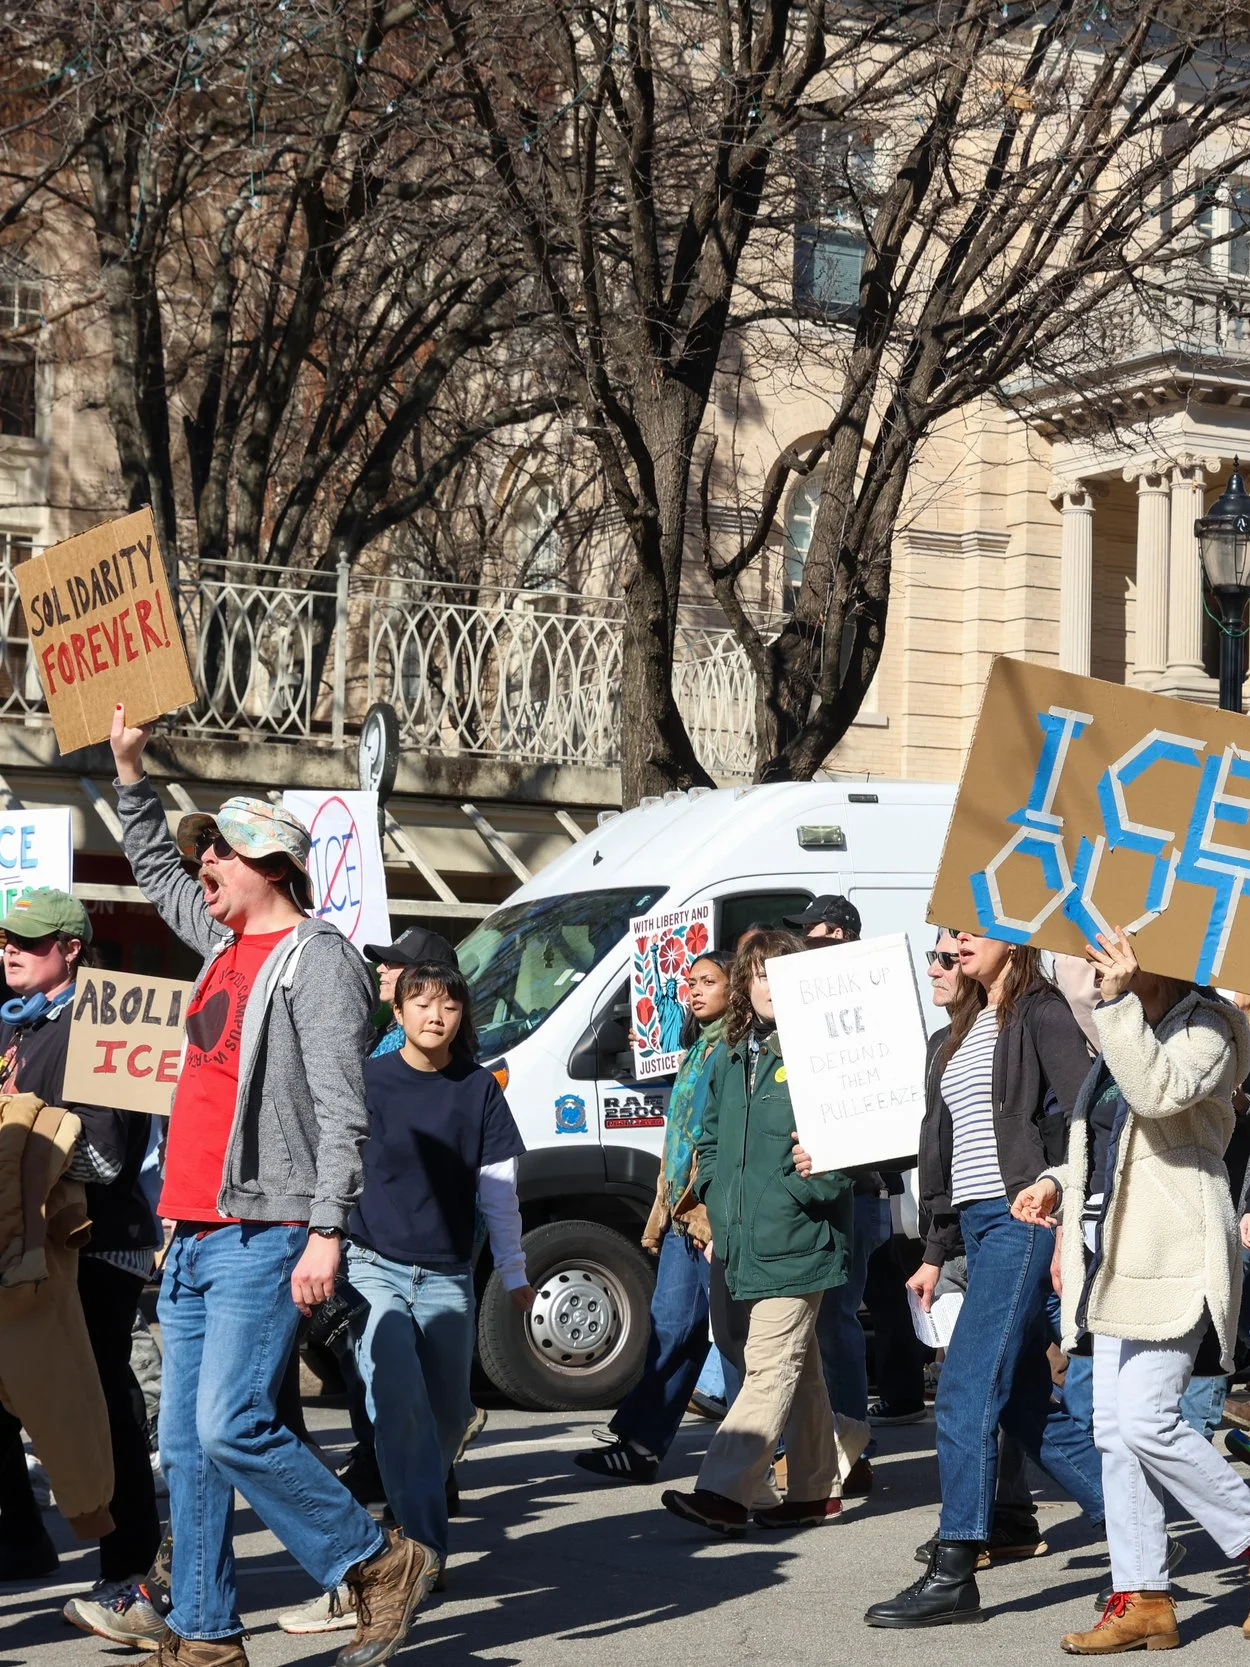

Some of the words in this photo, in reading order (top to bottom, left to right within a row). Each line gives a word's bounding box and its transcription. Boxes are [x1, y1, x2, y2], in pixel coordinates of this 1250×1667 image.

[31, 535, 153, 637] SOLIDARITY
[41, 589, 172, 696] FOREVER!
[311, 832, 361, 917] ICE
[633, 918, 654, 934] WITH
[656, 909, 690, 929] LIBERTY
[691, 905, 709, 921] AND
[73, 978, 183, 1028] ABOLI
[798, 972, 862, 1005] BREAK
[869, 967, 891, 986] UP
[824, 1005, 866, 1039] ICE
[92, 1039, 182, 1083] ICE
[639, 1056, 677, 1075] JUSTICE
[809, 1042, 891, 1075] DEFUND
[838, 1067, 881, 1090] THEM
[604, 1095, 664, 1108] RAM
[605, 1105, 664, 1118] 2500
